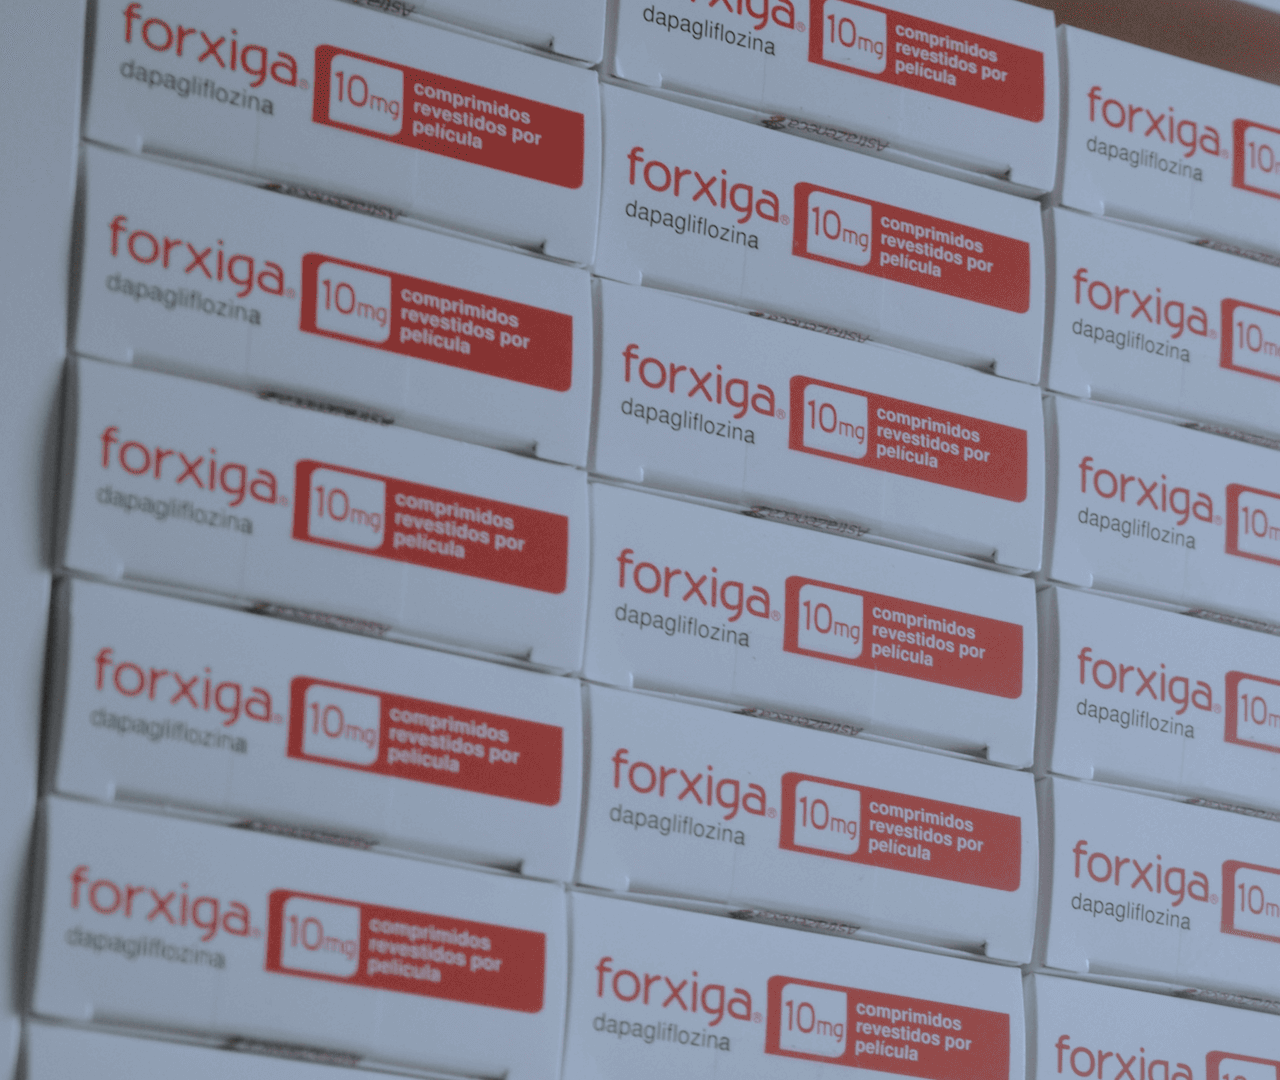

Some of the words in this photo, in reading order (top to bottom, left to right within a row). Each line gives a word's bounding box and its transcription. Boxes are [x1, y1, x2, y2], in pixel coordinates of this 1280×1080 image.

[641, 6, 775, 57] dapagliflozina
[826, 13, 885, 61] 10mg
[895, 24, 999, 63] comprimidos
[895, 41, 979, 74] revestidos
[981, 64, 1009, 82] por
[895, 58, 957, 86] película
[334, 70, 400, 122] 10mg
[625, 199, 759, 250] dapagliflozina
[811, 205, 869, 253] 10mg
[880, 215, 984, 254] comprimidos
[879, 251, 942, 278] película
[880, 233, 964, 266] revestidos
[966, 256, 994, 274] por
[107, 273, 261, 326] dapagliflozina
[321, 278, 388, 328] 10mg
[400, 288, 520, 328] comprimidos
[400, 306, 496, 341] revestidos
[500, 330, 532, 349] por
[400, 325, 472, 354] película
[619, 397, 755, 445] dapagliflozina
[807, 399, 866, 445] 10mg
[876, 407, 982, 443] comprimidos
[876, 442, 939, 469] película
[877, 424, 961, 456] revestidos
[964, 445, 992, 463] por
[314, 484, 381, 534] 10mg
[1078, 506, 1198, 550] dapagliflozina
[614, 603, 750, 648] dapagliflozina
[802, 599, 861, 645] 10mg
[872, 606, 977, 640] comprimidos
[872, 624, 956, 653] revestidos
[959, 642, 987, 659] por
[871, 642, 934, 667] película
[309, 701, 376, 750] 10mg
[798, 795, 858, 841] 10mg
[784, 999, 845, 1043] 10mg
